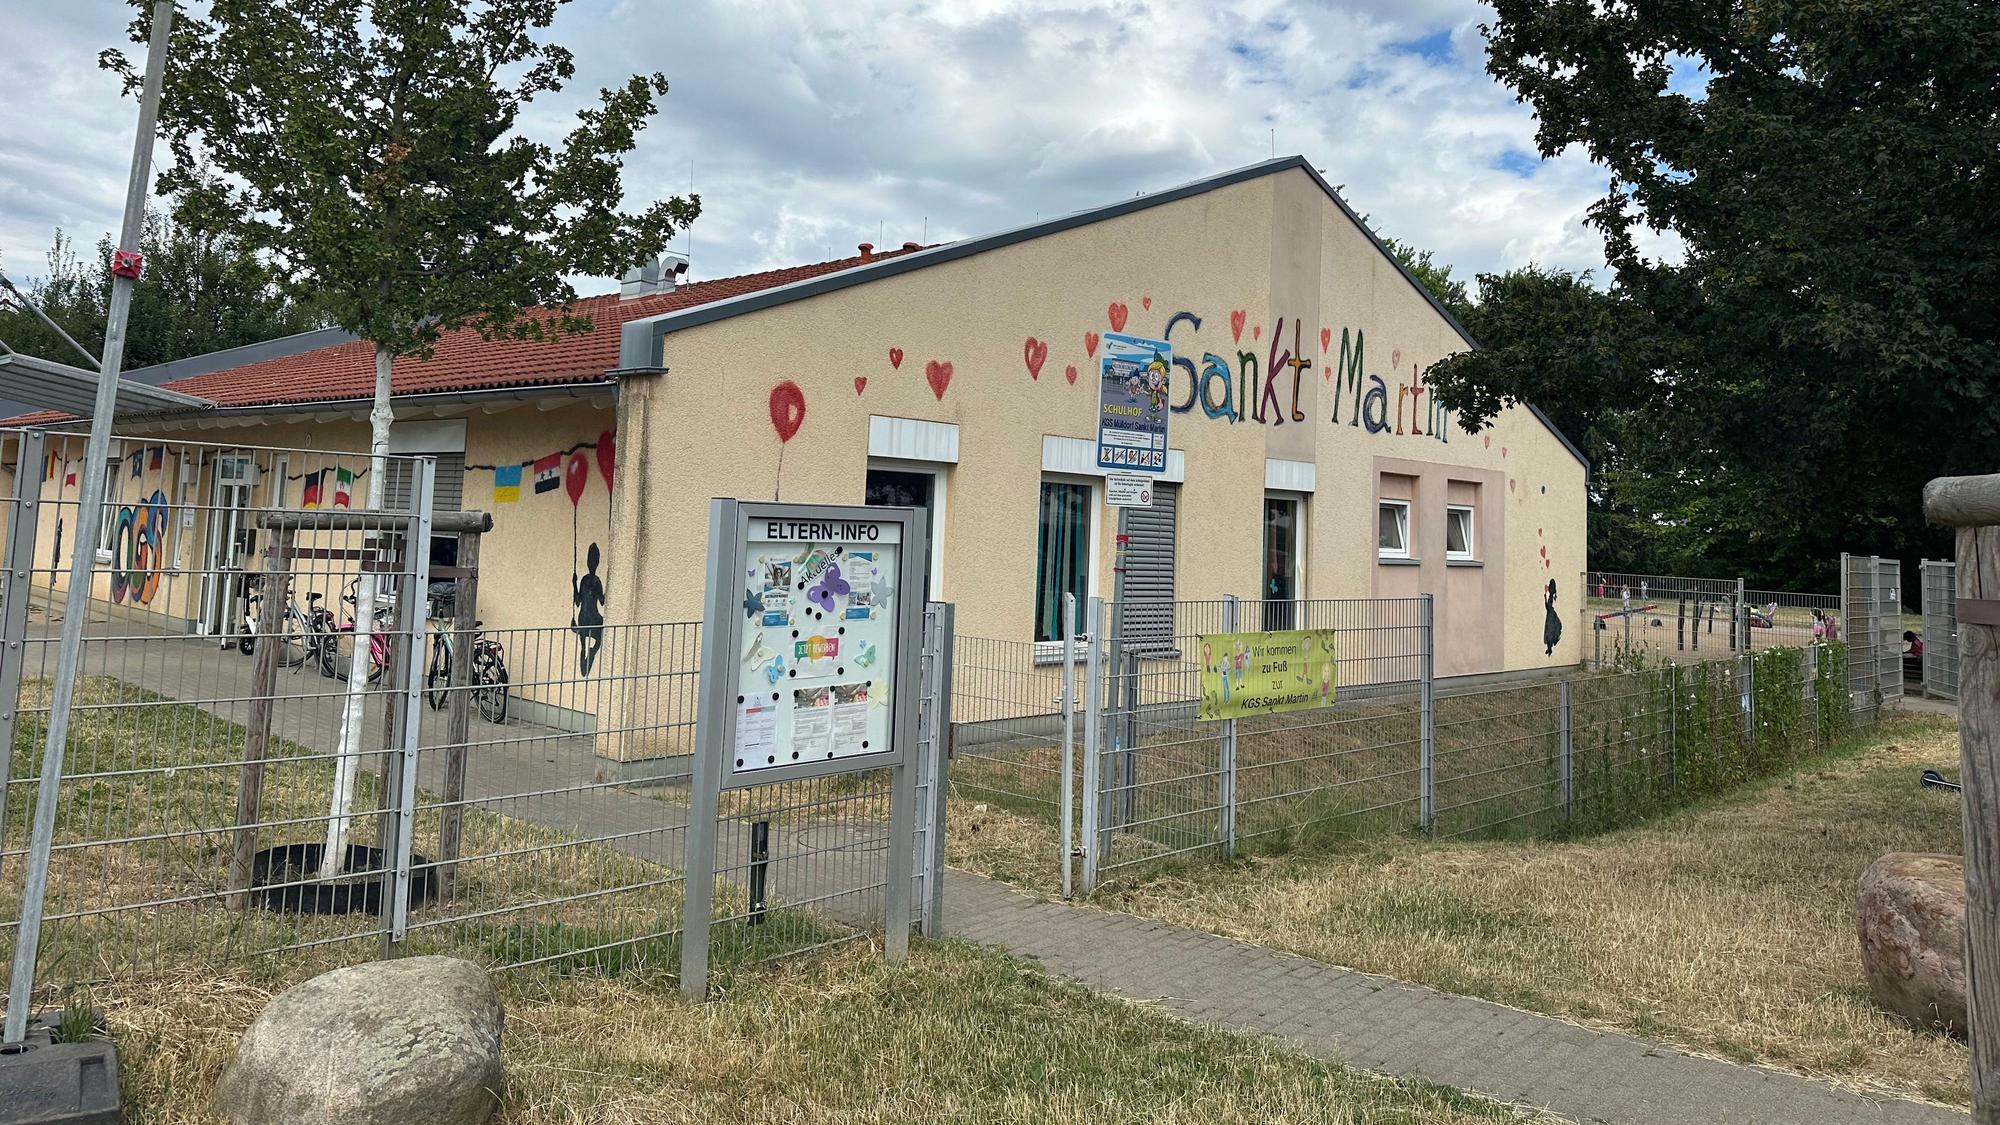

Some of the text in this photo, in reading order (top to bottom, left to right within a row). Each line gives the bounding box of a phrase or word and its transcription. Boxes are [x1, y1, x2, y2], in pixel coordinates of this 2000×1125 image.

[1165, 312, 1311, 426] Sankt
[1103, 404, 1143, 417] SCHULHOF
[1102, 418, 1113, 427] KGS
[1134, 421, 1149, 431] Sankt
[1150, 423, 1165, 432] Martin
[767, 522, 879, 541] ELTERN-INFO
[1252, 644, 1297, 657] Wir kommen
[1262, 660, 1288, 674] zu Fuß
[1272, 680, 1283, 690] zur
[1241, 692, 1309, 710] KGS Sankt Martin
